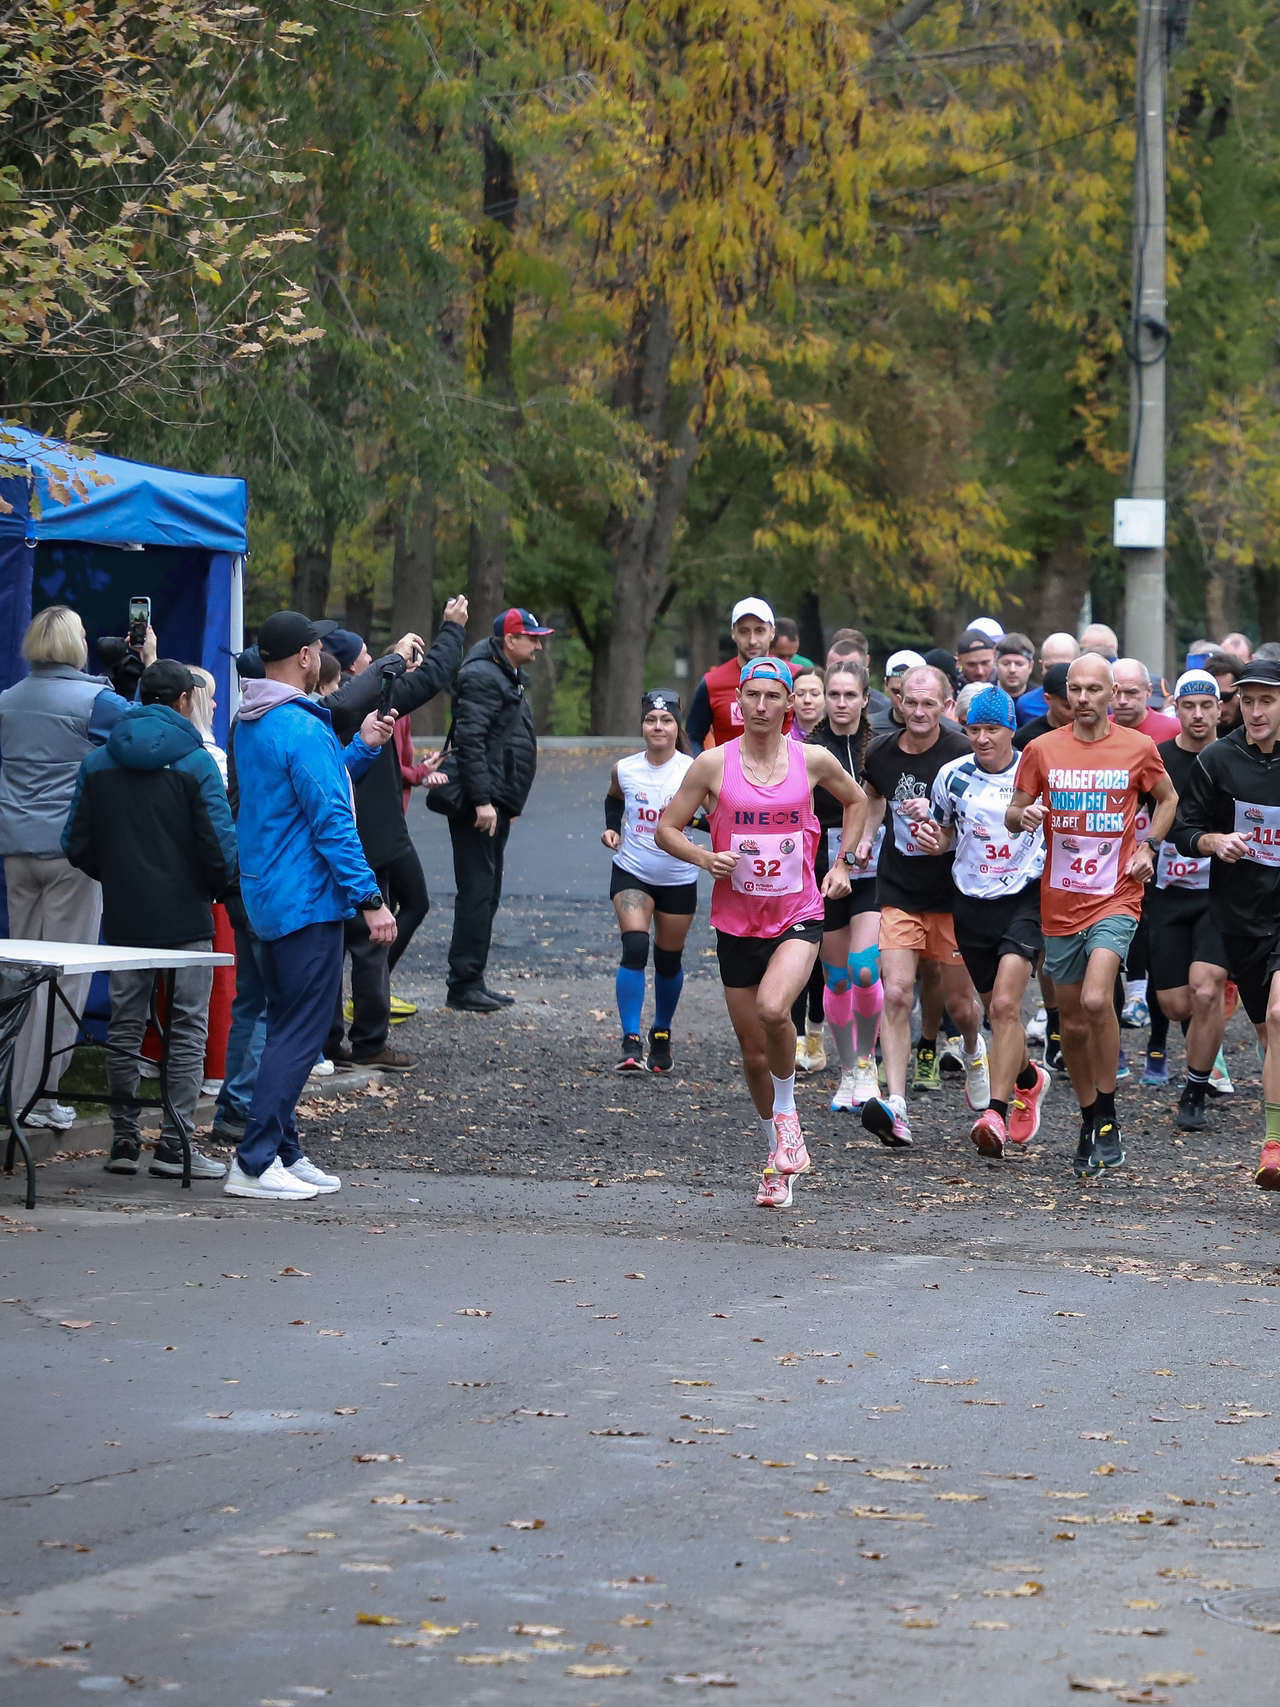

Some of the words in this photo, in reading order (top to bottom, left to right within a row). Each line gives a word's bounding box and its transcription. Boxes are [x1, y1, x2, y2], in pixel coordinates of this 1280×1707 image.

[1048, 769, 1130, 790] #ЗАБЕГ2025
[637, 807, 666, 822] 10
[735, 810, 799, 825] INEOS
[985, 844, 1012, 860] 34
[753, 859, 781, 877] 32
[1070, 857, 1098, 876] 46
[1166, 861, 1199, 877] 102
